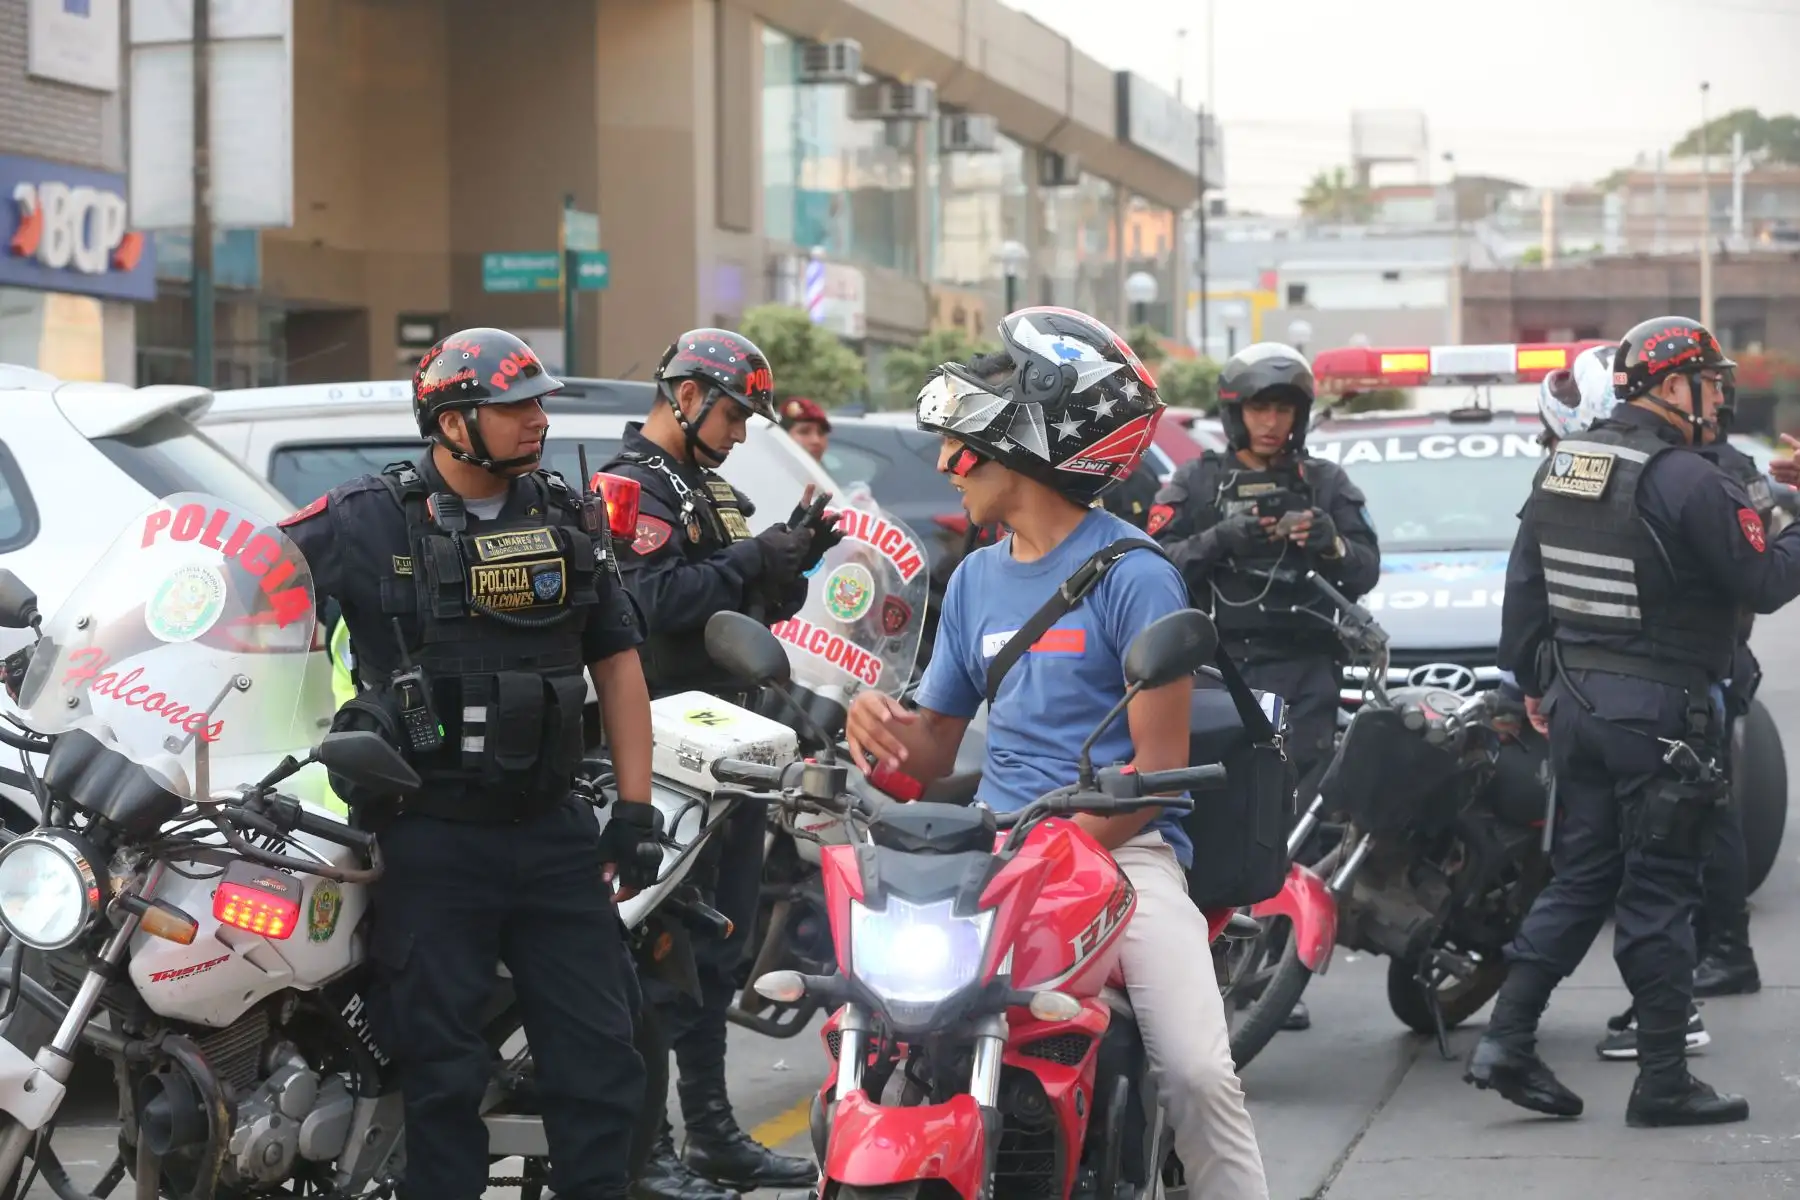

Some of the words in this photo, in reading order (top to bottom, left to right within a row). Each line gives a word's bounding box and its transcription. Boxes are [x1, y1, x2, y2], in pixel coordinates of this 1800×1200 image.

[37, 180, 127, 274] BCP
[1306, 433, 1542, 466] HALCON
[140, 503, 312, 630] POLICIA
[478, 567, 530, 593] POLICIA
[61, 647, 225, 743] Halcones
